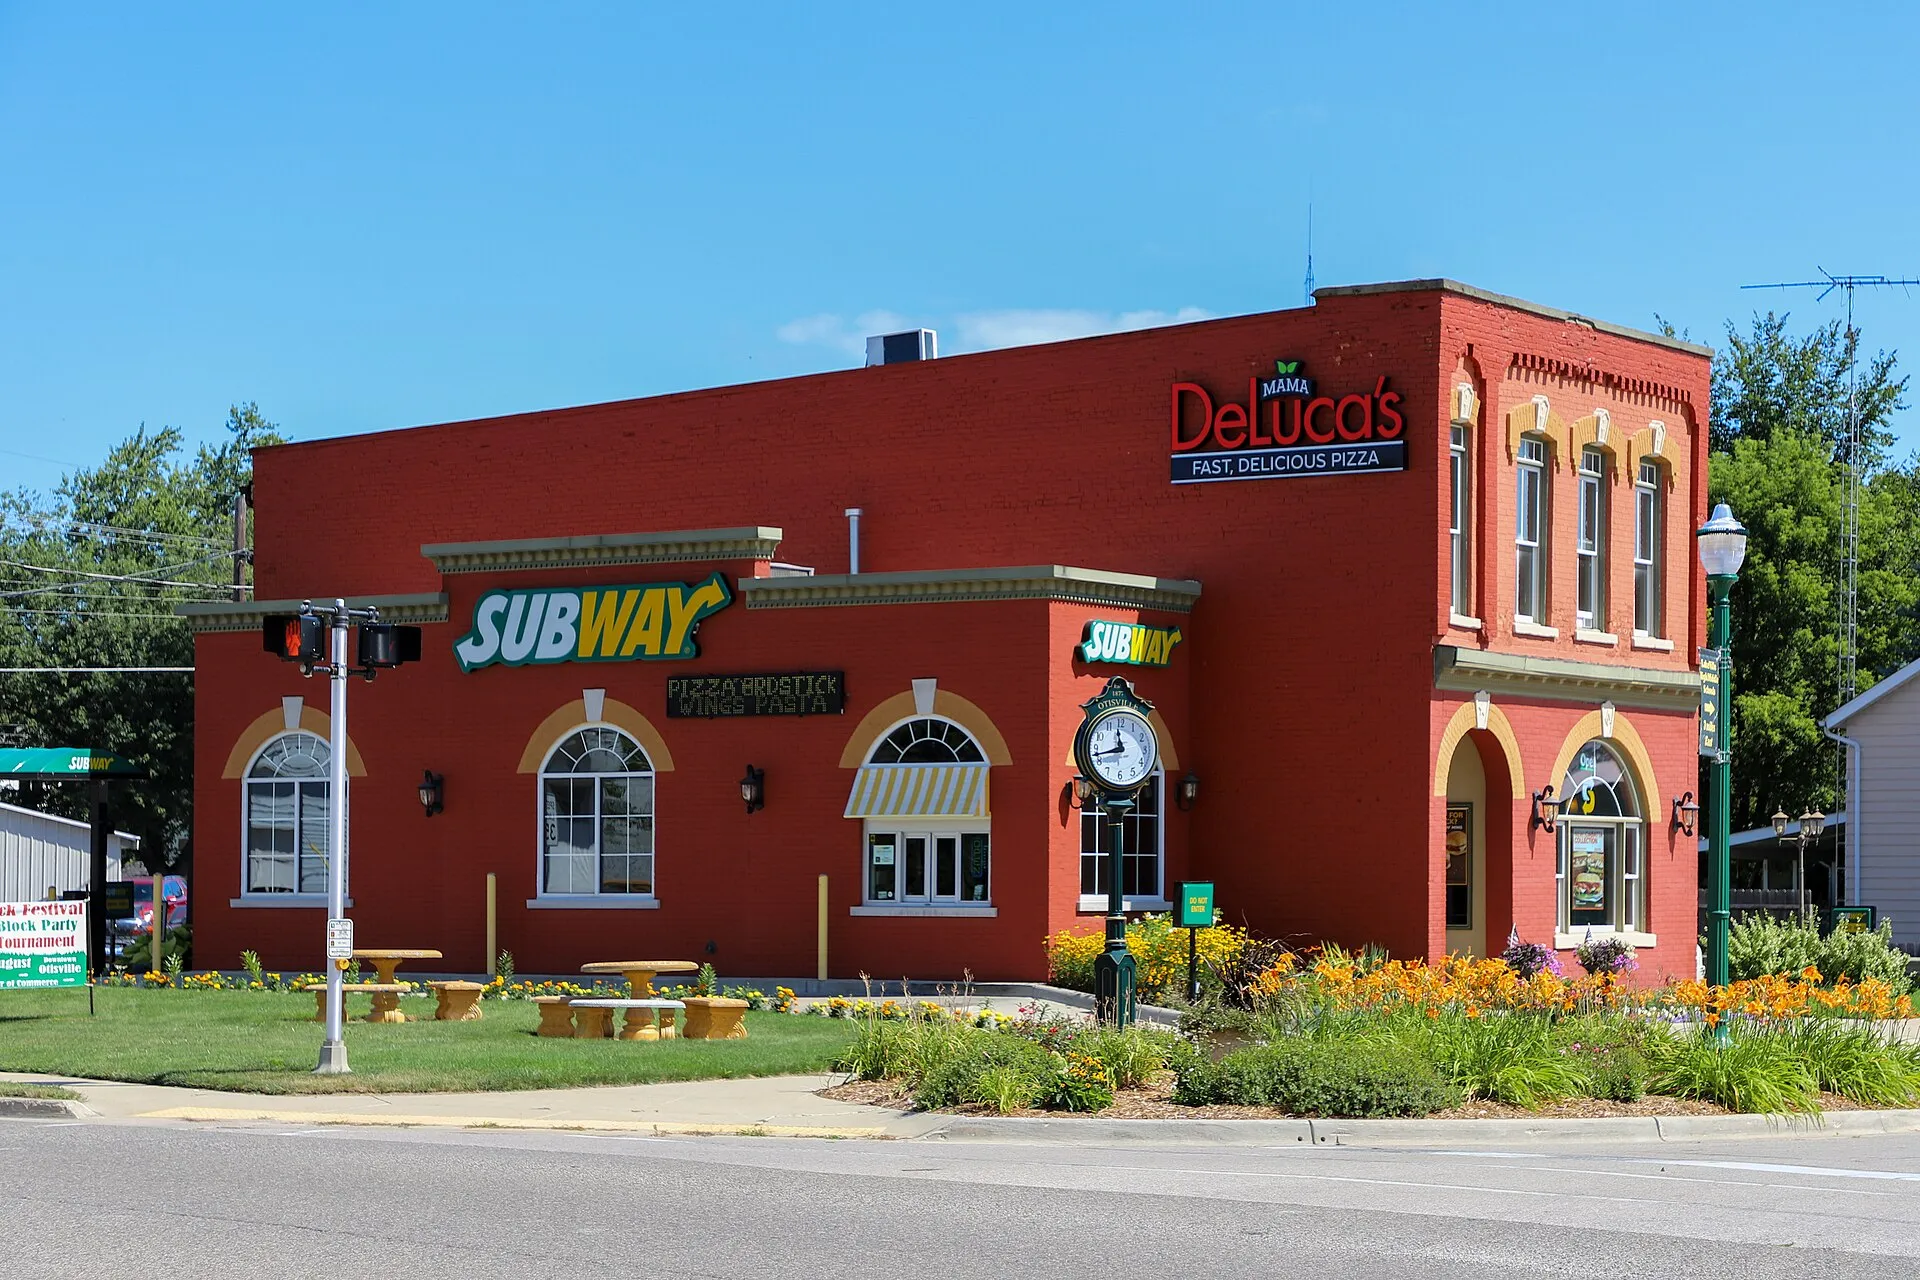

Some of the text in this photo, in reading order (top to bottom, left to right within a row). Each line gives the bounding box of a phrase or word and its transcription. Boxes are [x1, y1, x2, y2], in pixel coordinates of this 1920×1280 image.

[1263, 378, 1309, 397] MAMA
[1171, 375, 1402, 450] DeLuca's
[1192, 450, 1379, 476] FAST, DELICIOUS PIZZA
[456, 578, 725, 667] SUBWAY
[1085, 622, 1182, 665] SUBWAY
[669, 678, 735, 698] PIZZA
[680, 693, 826, 715] WINGS PASTA
[1098, 699, 1138, 710] OTISVILLE
[1106, 722, 1112, 731] 11
[1117, 719, 1125, 728] 12
[1096, 732, 1104, 741] 10
[1140, 733, 1144, 742] 2
[68, 757, 113, 770] SUBWAY
[1097, 756, 1102, 766] 8
[1139, 758, 1144, 767] 4
[1580, 753, 1594, 770] Ope
[1105, 767, 1110, 776] 7
[1117, 771, 1122, 780] 6
[1130, 767, 1136, 776] 5
[22, 903, 83, 916] Festival
[41, 919, 78, 932] Party
[38, 964, 82, 974] Otisville
[17, 979, 59, 987] Commerce
